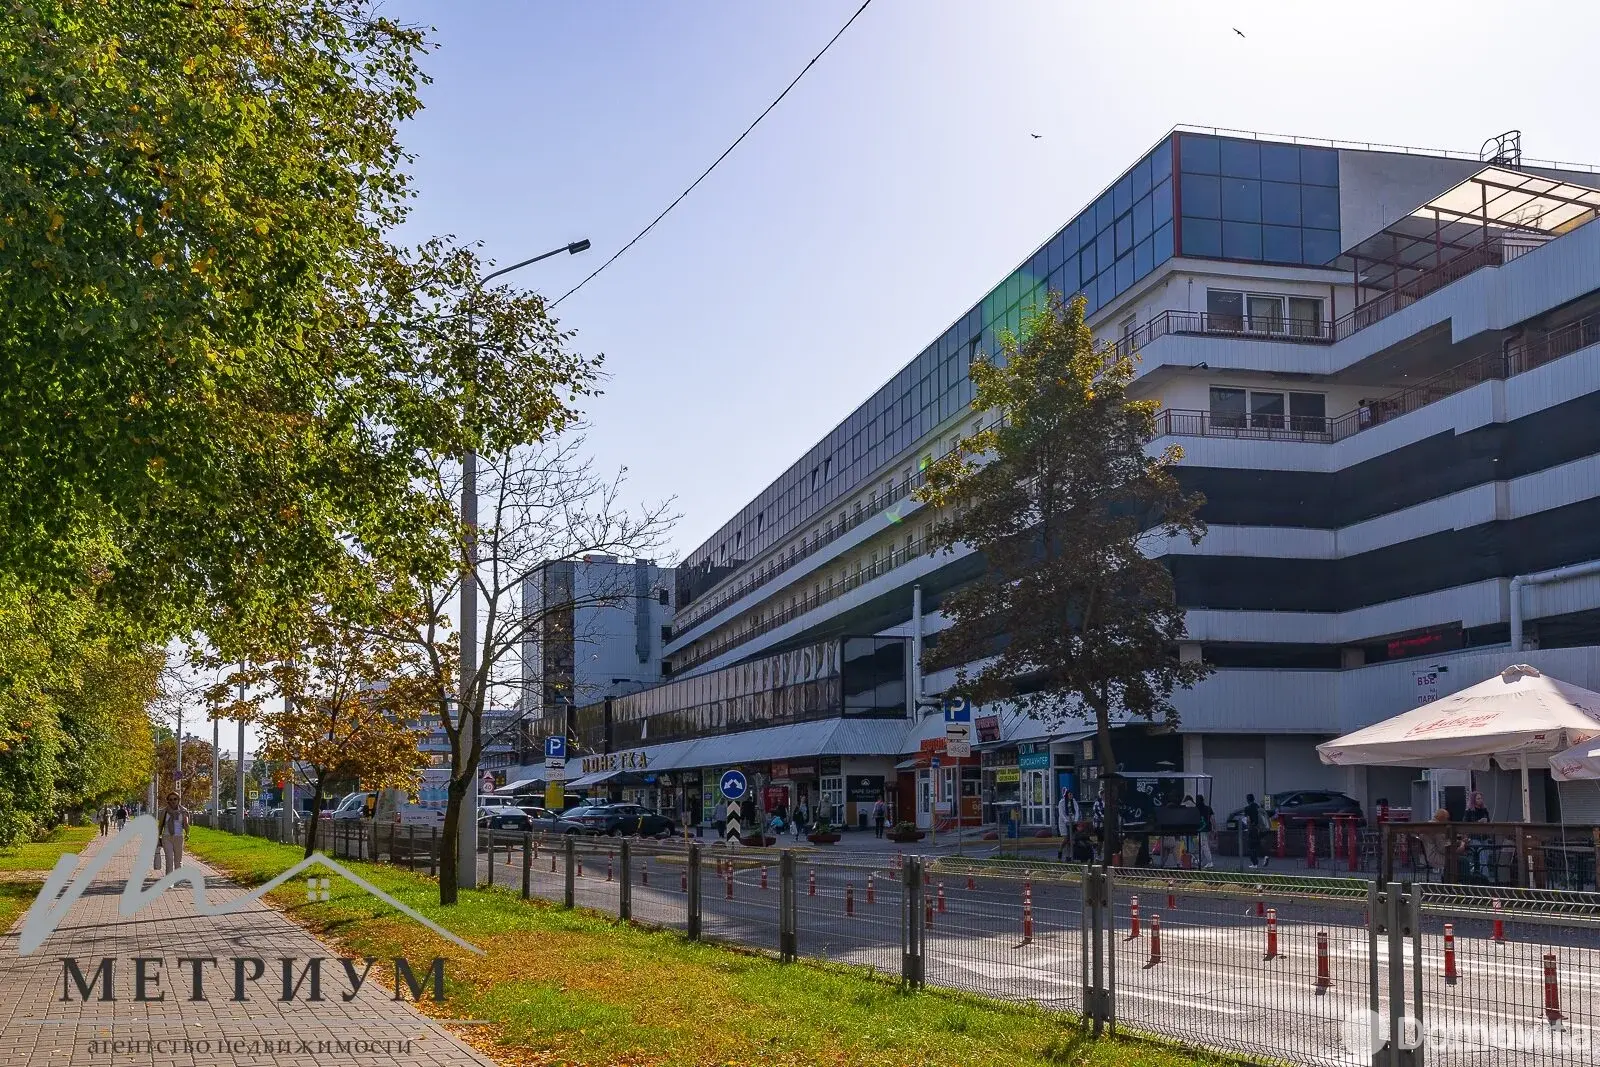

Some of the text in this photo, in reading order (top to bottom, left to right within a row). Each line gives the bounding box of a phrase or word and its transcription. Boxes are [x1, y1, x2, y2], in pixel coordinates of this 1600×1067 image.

[1417, 676, 1438, 686] ВЪЕ
[950, 696, 965, 720] P
[550, 738, 561, 755] P
